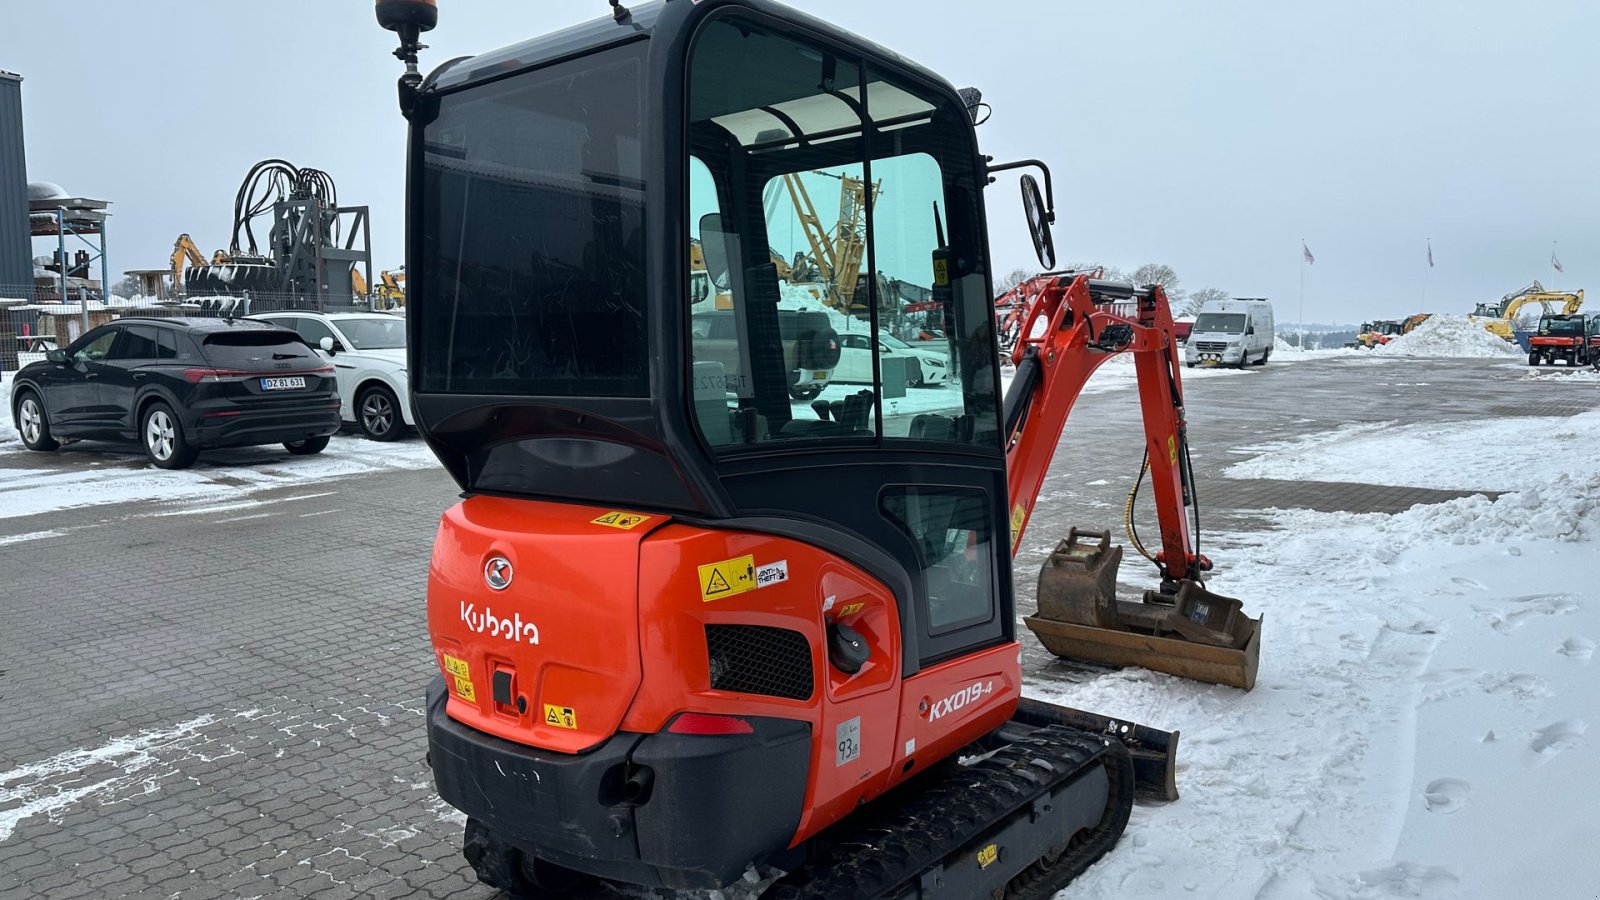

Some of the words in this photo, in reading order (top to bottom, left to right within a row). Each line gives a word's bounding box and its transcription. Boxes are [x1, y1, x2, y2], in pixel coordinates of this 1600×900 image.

[267, 379, 278, 387] DZ
[279, 378, 288, 386] 81
[290, 378, 303, 386] 631
[758, 573, 776, 583] THEFT
[460, 600, 539, 645] Kubota
[929, 681, 993, 723] KX019-4
